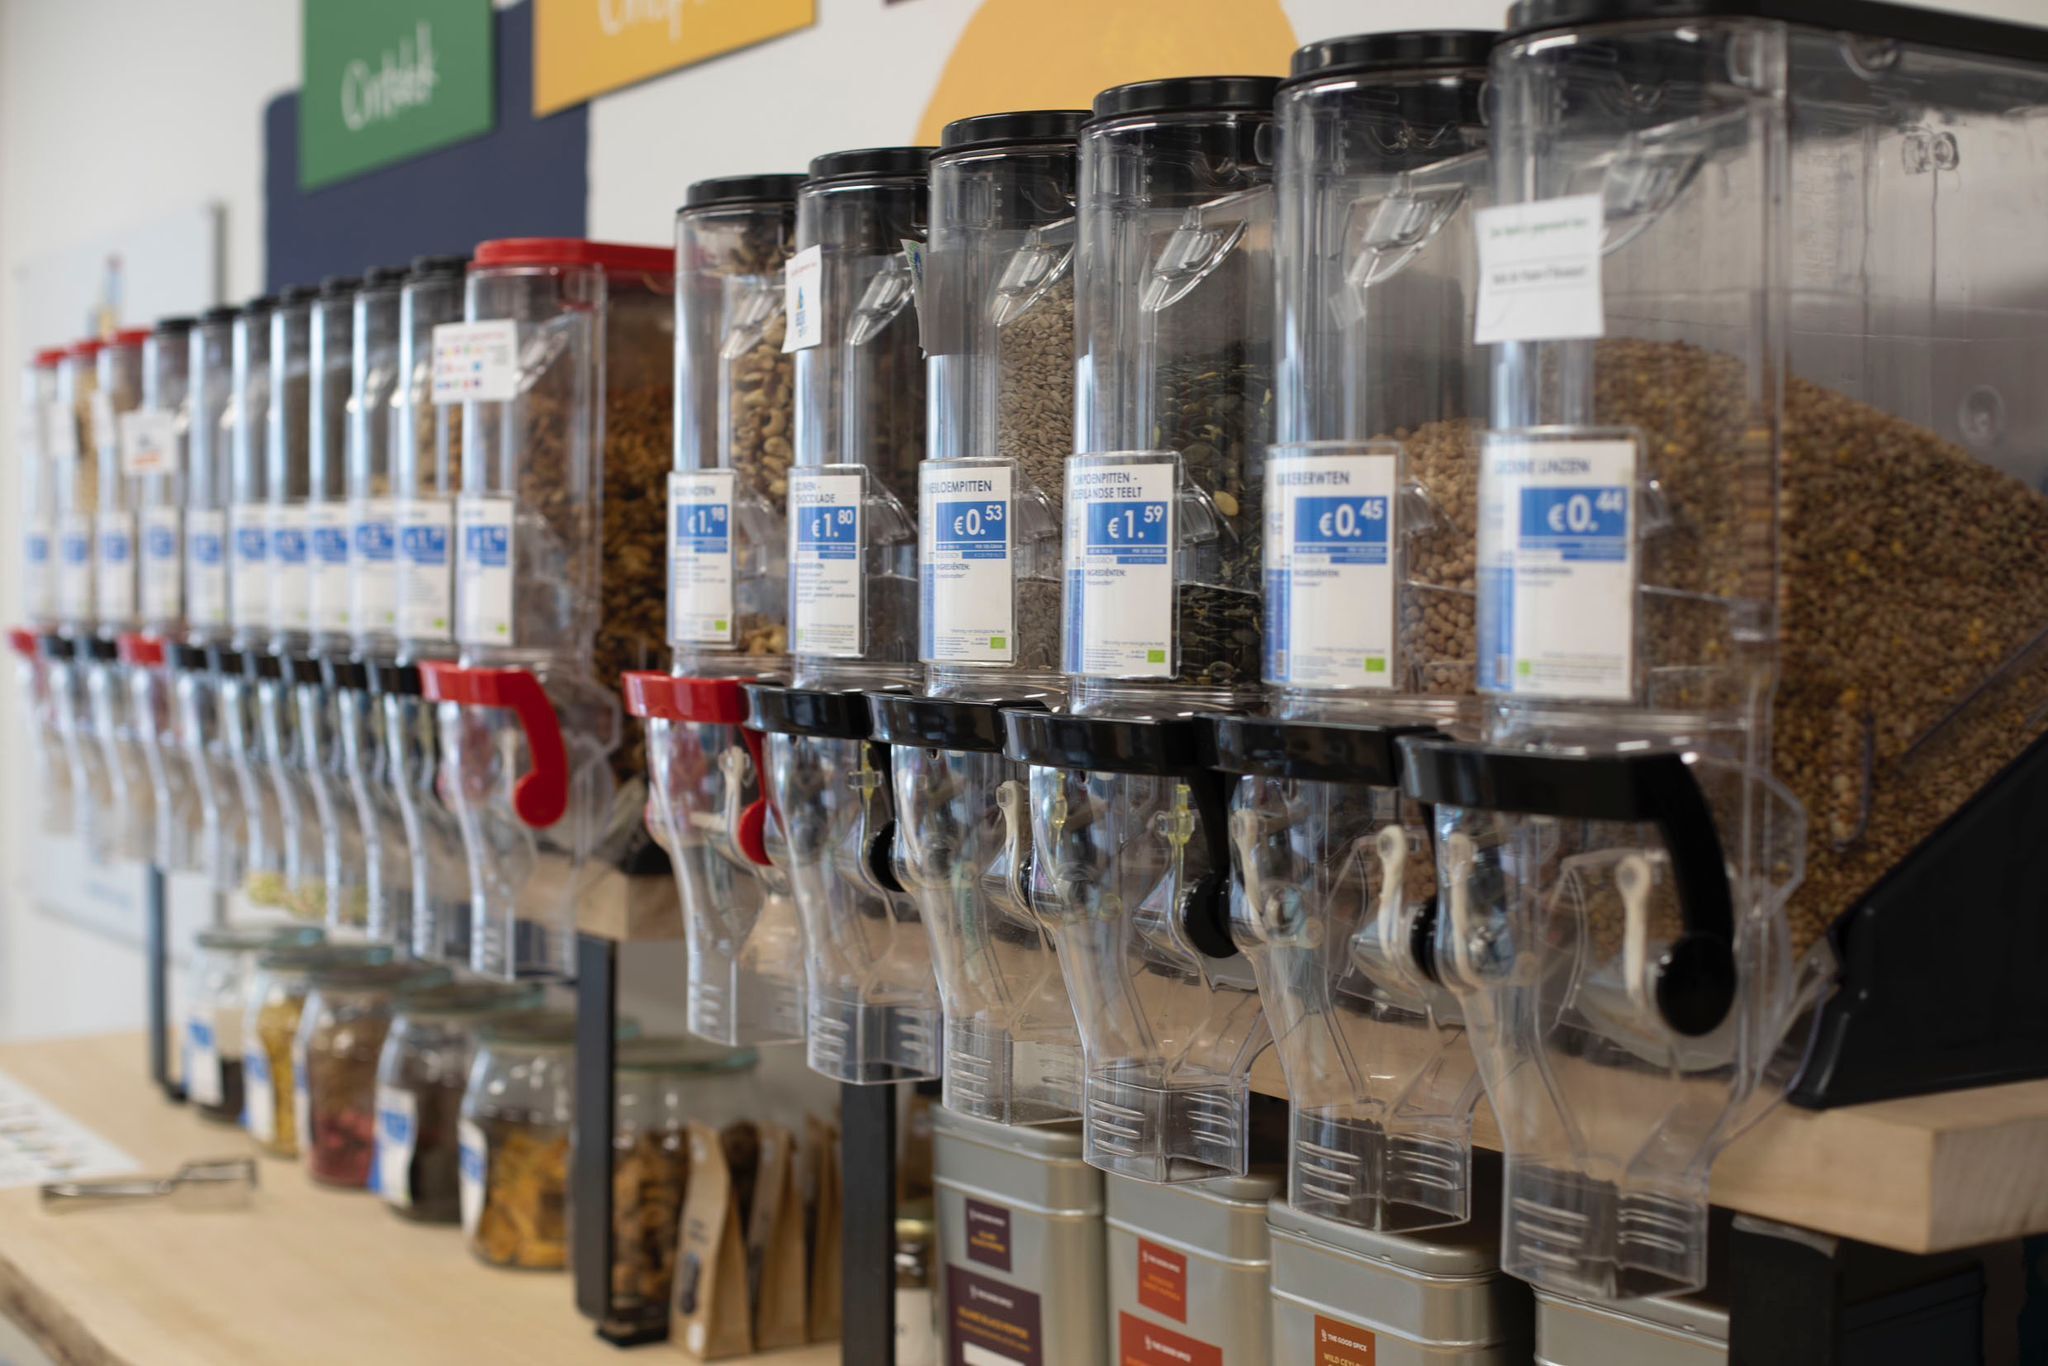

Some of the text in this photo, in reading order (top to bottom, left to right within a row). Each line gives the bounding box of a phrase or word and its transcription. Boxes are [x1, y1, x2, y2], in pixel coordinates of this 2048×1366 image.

[1116, 487, 1142, 498] TEELT
[811, 509, 854, 538] €1.80
[954, 505, 1002, 536] €0.53
[1107, 505, 1164, 539] €1.59
[1319, 500, 1384, 537] €0.45
